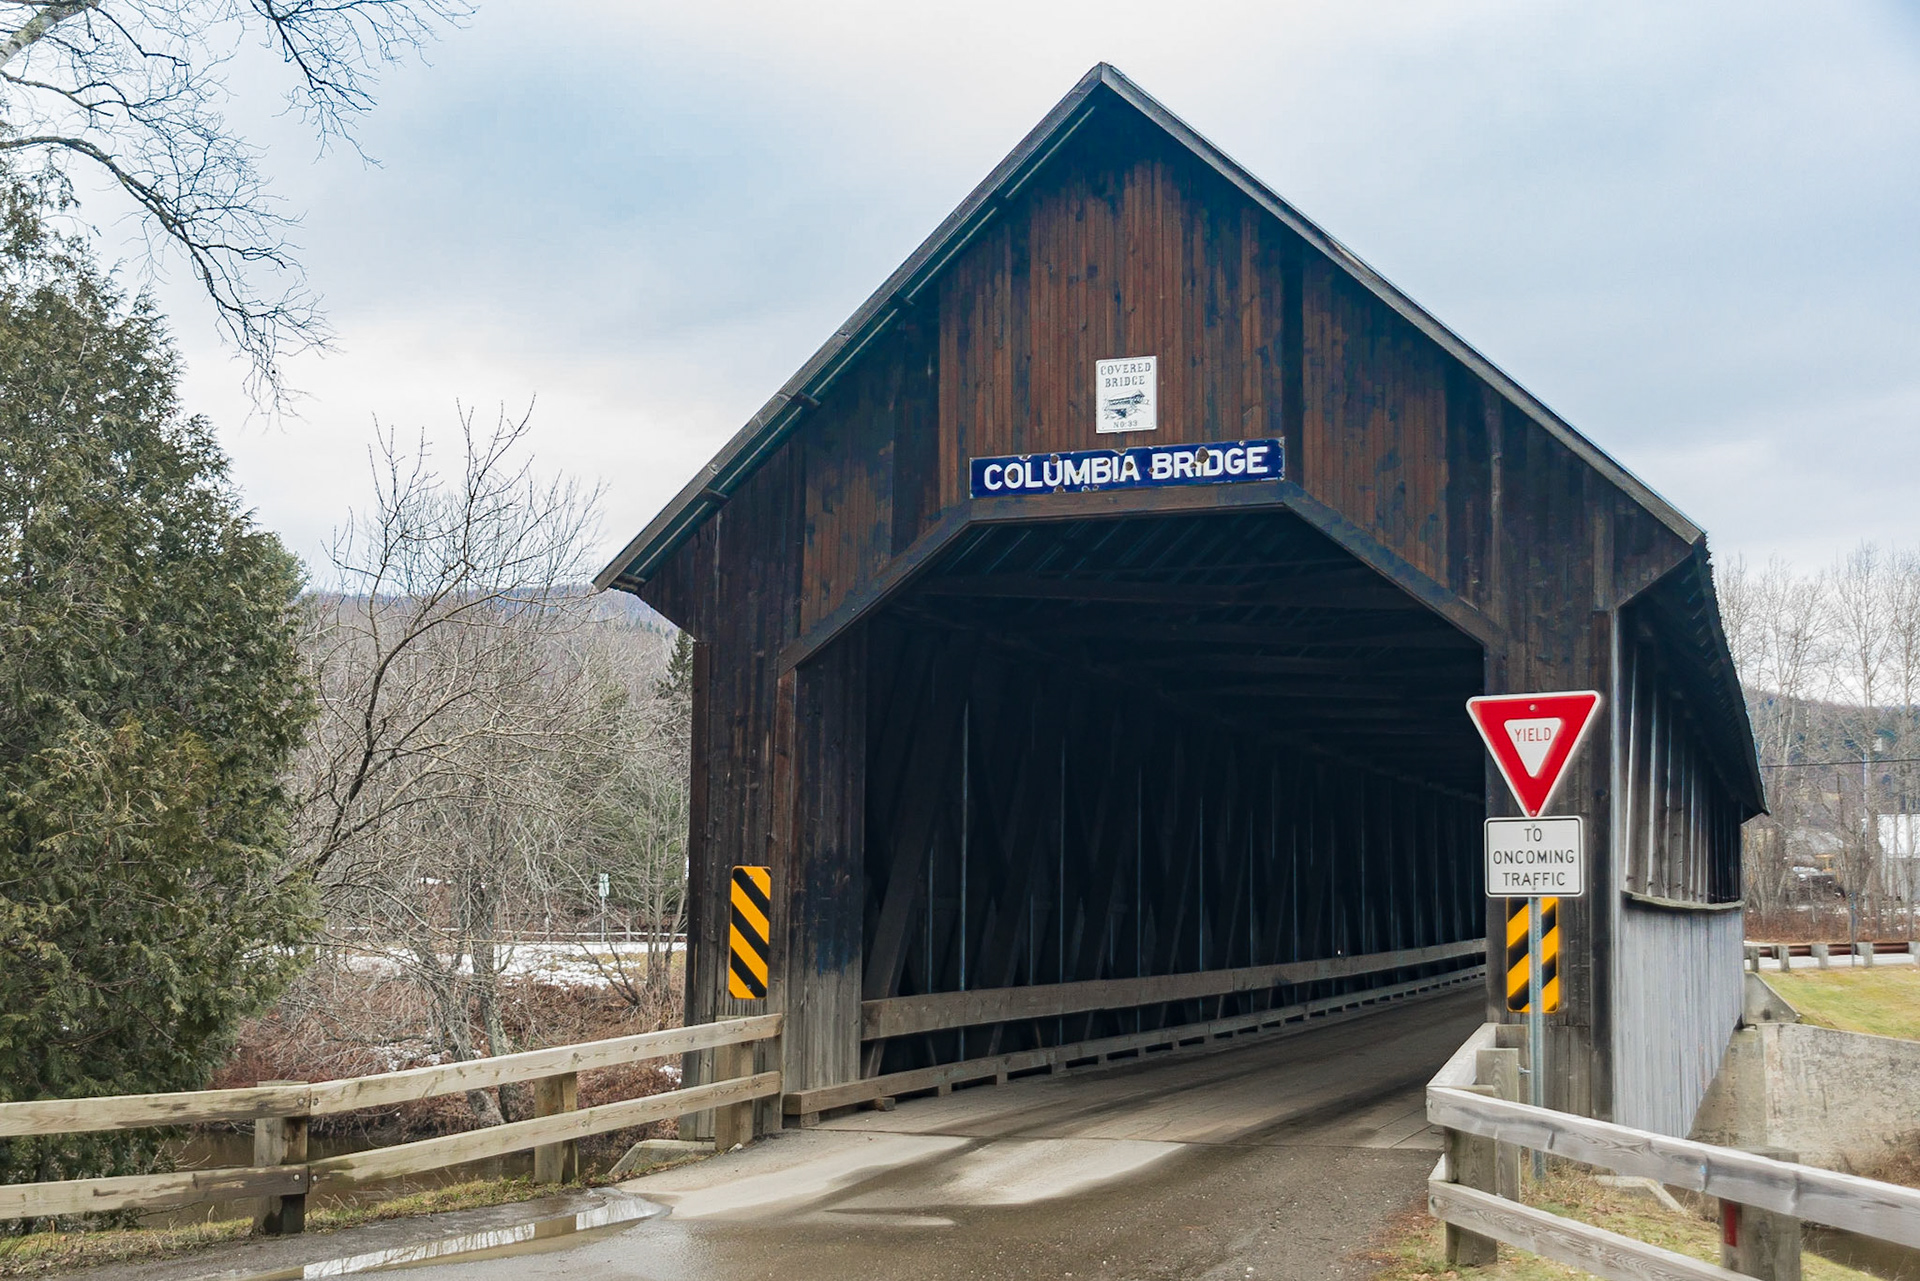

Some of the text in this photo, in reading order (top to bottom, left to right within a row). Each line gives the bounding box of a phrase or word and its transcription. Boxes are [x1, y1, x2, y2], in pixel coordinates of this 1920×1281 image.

[1100, 362, 1151, 376] COVERED
[1105, 375, 1145, 388] BRIDGE
[984, 447, 1268, 490] COLUMBIA BRIDGE
[1514, 727, 1551, 742] YIELD
[1524, 828, 1542, 842] TO
[1493, 850, 1575, 865] ONCOMING
[1502, 872, 1566, 886] TRAFFIC
